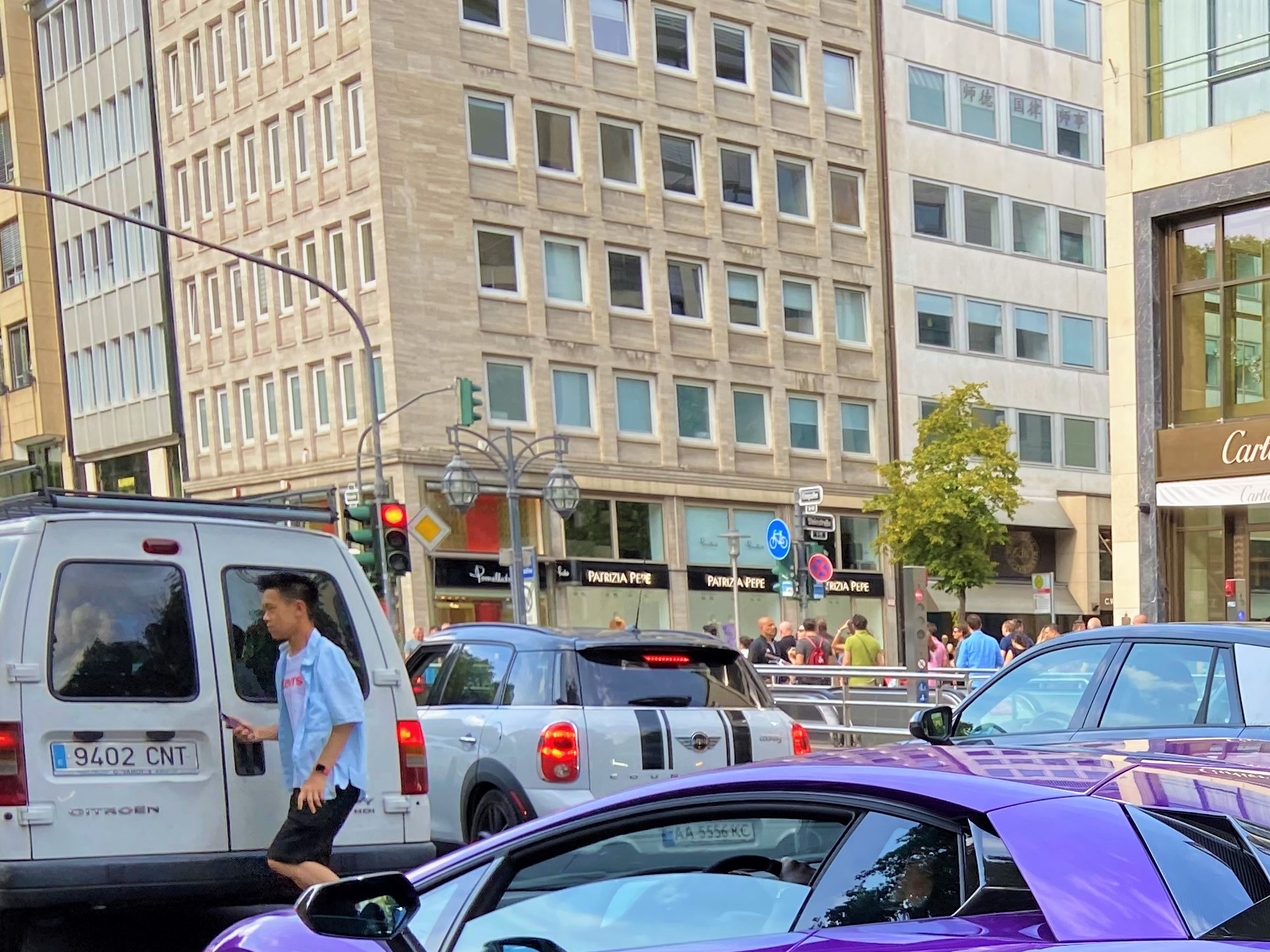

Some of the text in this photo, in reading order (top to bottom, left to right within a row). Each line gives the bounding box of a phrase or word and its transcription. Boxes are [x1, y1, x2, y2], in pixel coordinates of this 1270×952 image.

[587, 570, 652, 585] PATRIZIA PEPE
[707, 575, 765, 589] PATRIZA PEPE
[850, 580, 870, 592] PEPE
[74, 747, 135, 767] 9402
[146, 746, 187, 766] CNT
